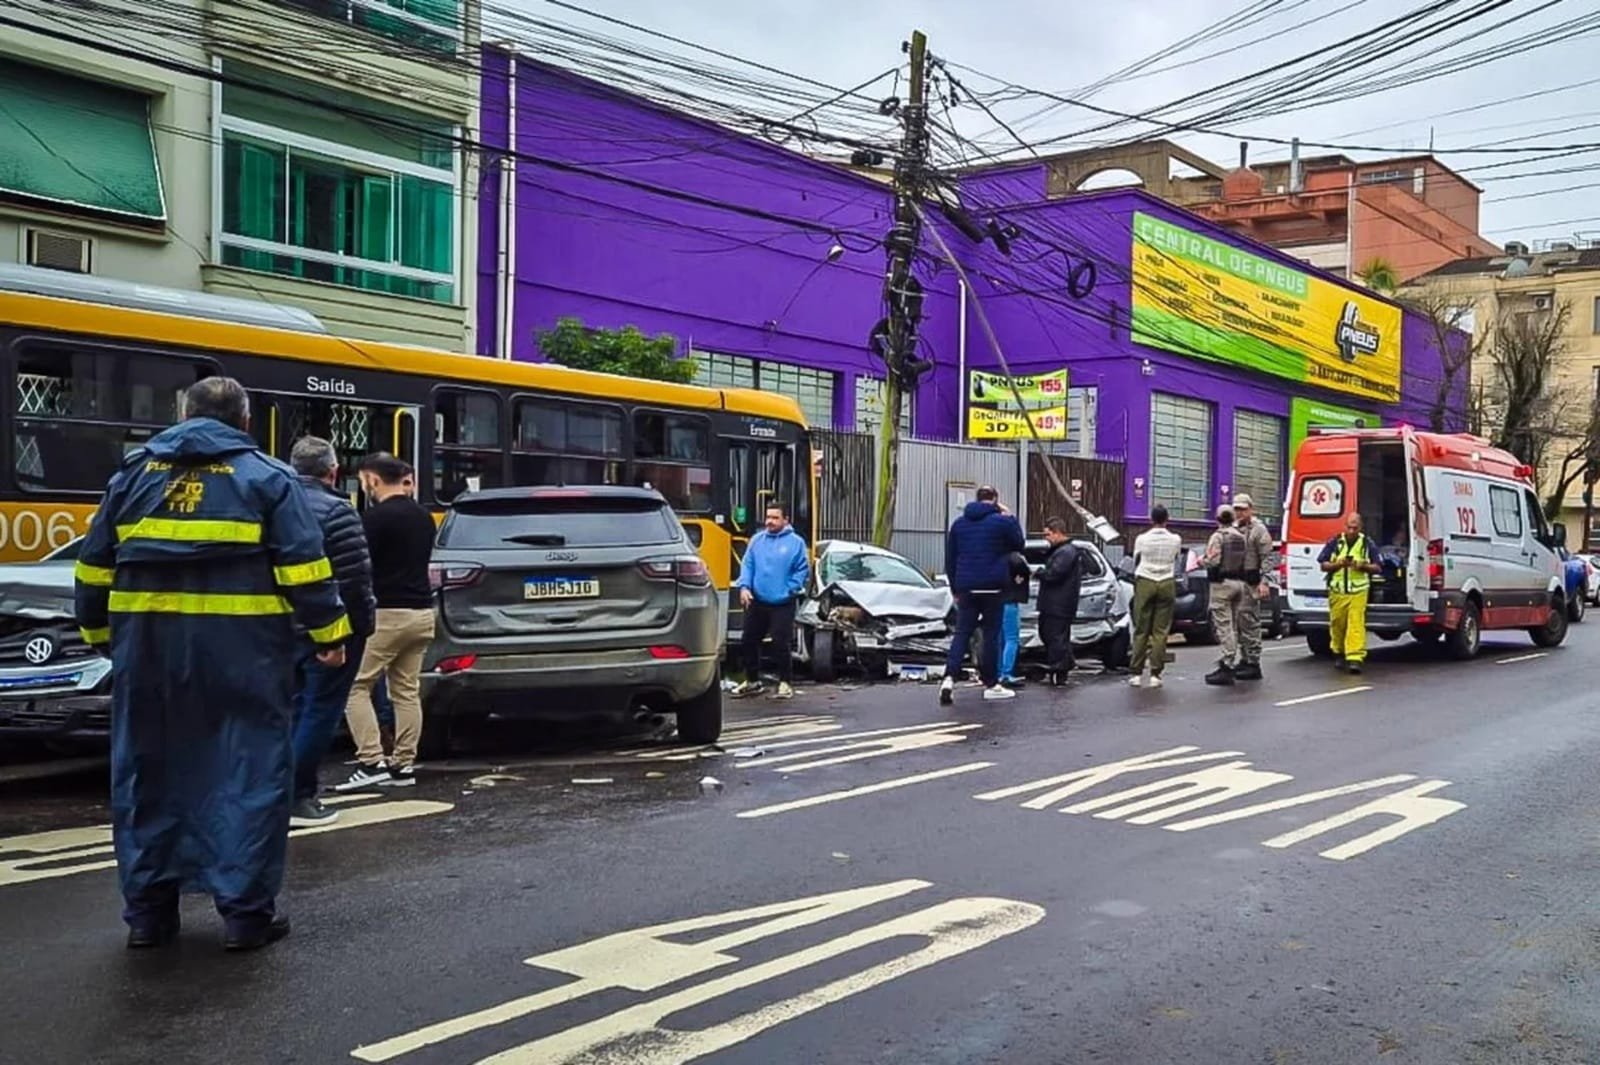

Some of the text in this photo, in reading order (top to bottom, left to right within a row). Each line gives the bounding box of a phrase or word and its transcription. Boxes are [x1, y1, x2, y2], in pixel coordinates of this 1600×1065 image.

[1140, 221, 1225, 268] CENTRAL
[1229, 253, 1254, 275] DE
[1255, 263, 1306, 295] PNEUS
[1340, 326, 1378, 349] PNEUS
[990, 375, 1034, 387] PNUS
[985, 422, 1009, 433] 3D
[0, 510, 98, 551] 06
[1457, 507, 1477, 534] 192
